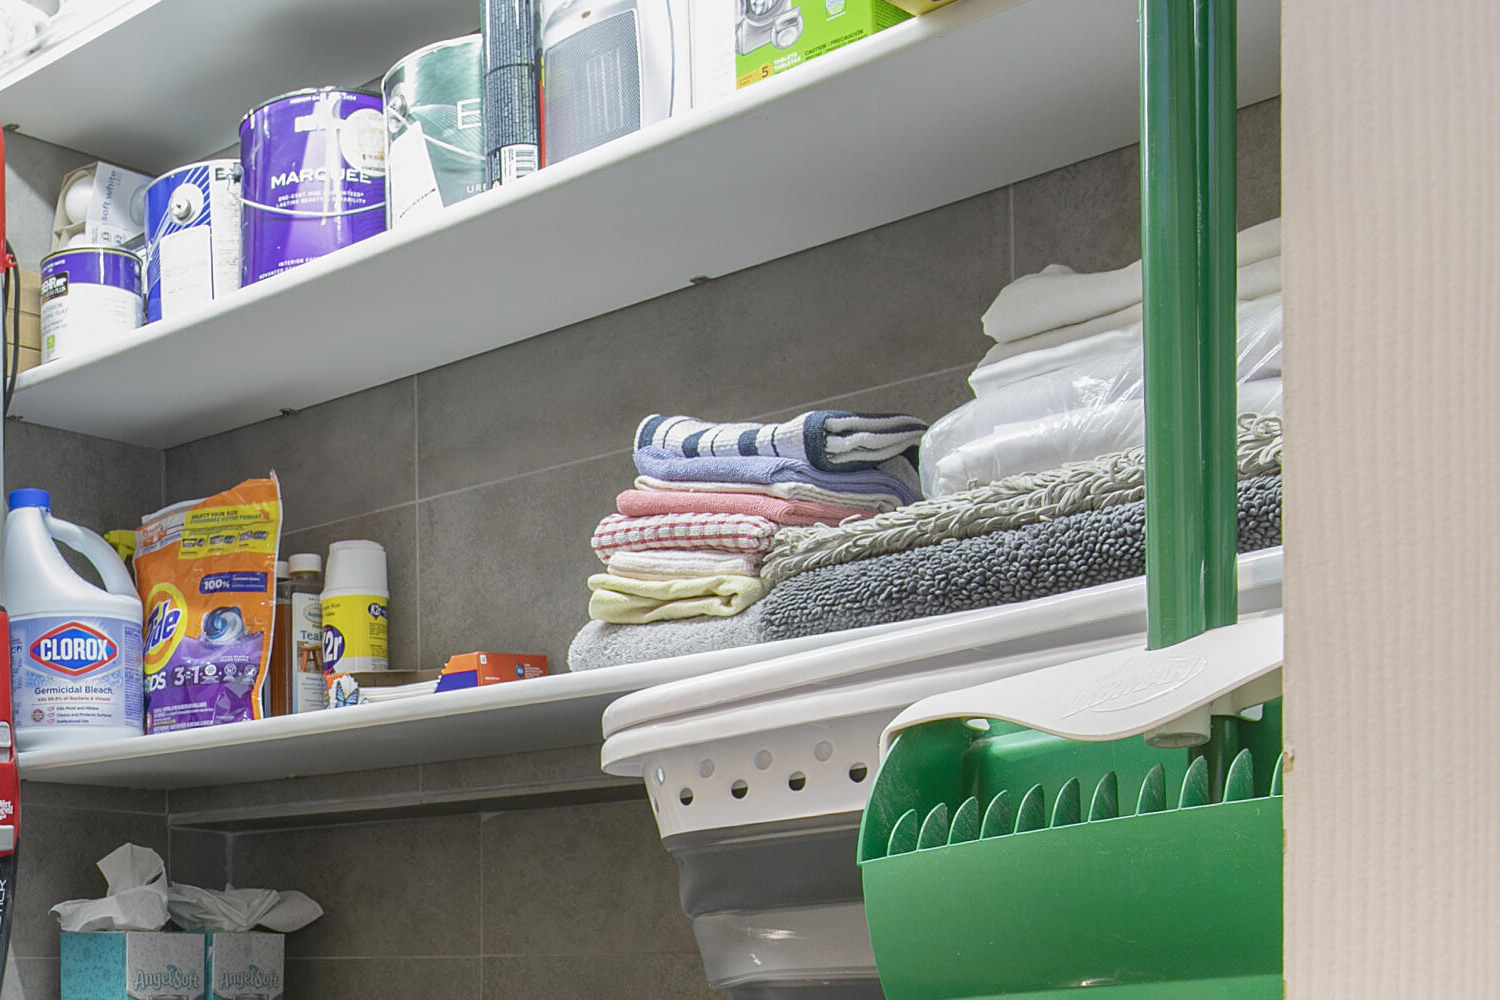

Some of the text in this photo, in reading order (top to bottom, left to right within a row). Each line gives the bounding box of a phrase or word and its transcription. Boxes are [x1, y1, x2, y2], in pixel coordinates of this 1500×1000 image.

[762, 66, 769, 78] 5
[203, 579, 230, 590] 100%
[143, 599, 182, 655] Tide
[40, 638, 109, 661] CLOROX
[34, 686, 113, 695] Germicidal Bleach
